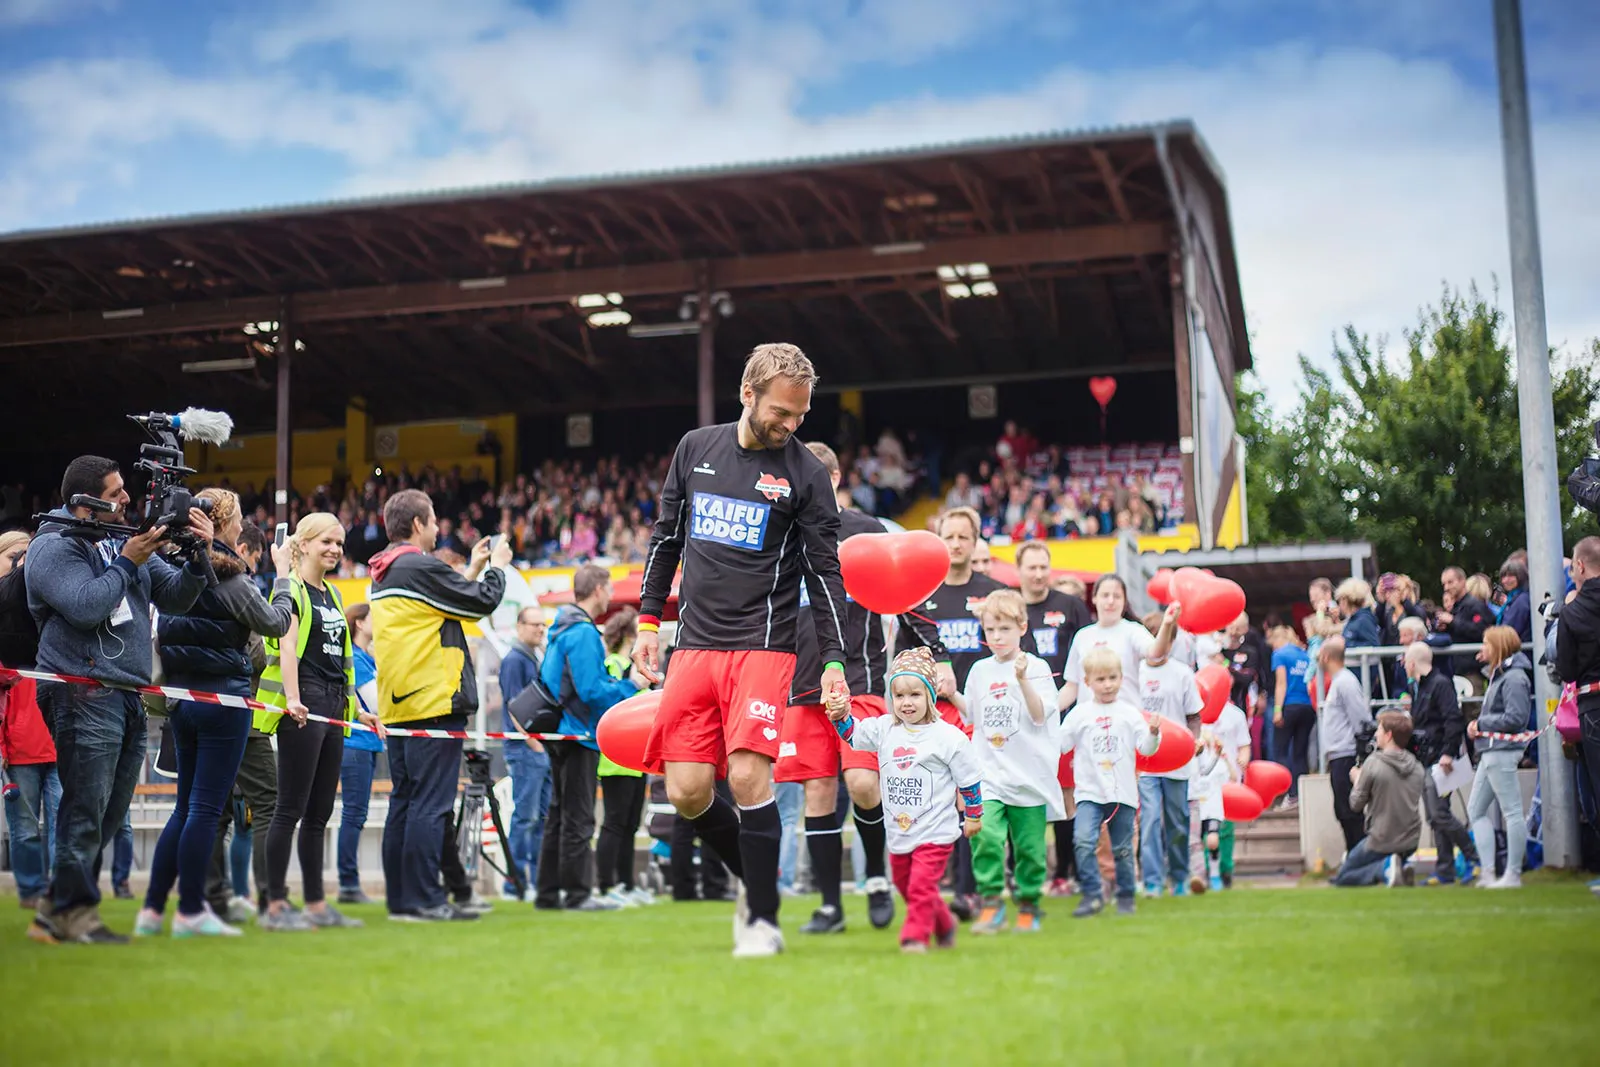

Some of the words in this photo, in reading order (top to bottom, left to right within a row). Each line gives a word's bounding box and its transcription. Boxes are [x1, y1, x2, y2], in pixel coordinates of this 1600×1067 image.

[695, 496, 765, 527] KAIFU
[694, 515, 761, 545] LODGE
[936, 620, 980, 638] AIFU
[750, 700, 776, 720] OK!
[886, 775, 922, 788] KICKEN
[888, 786, 898, 794] MIT
[899, 787, 922, 796] HERZ
[888, 794, 922, 806] ROCKT!
